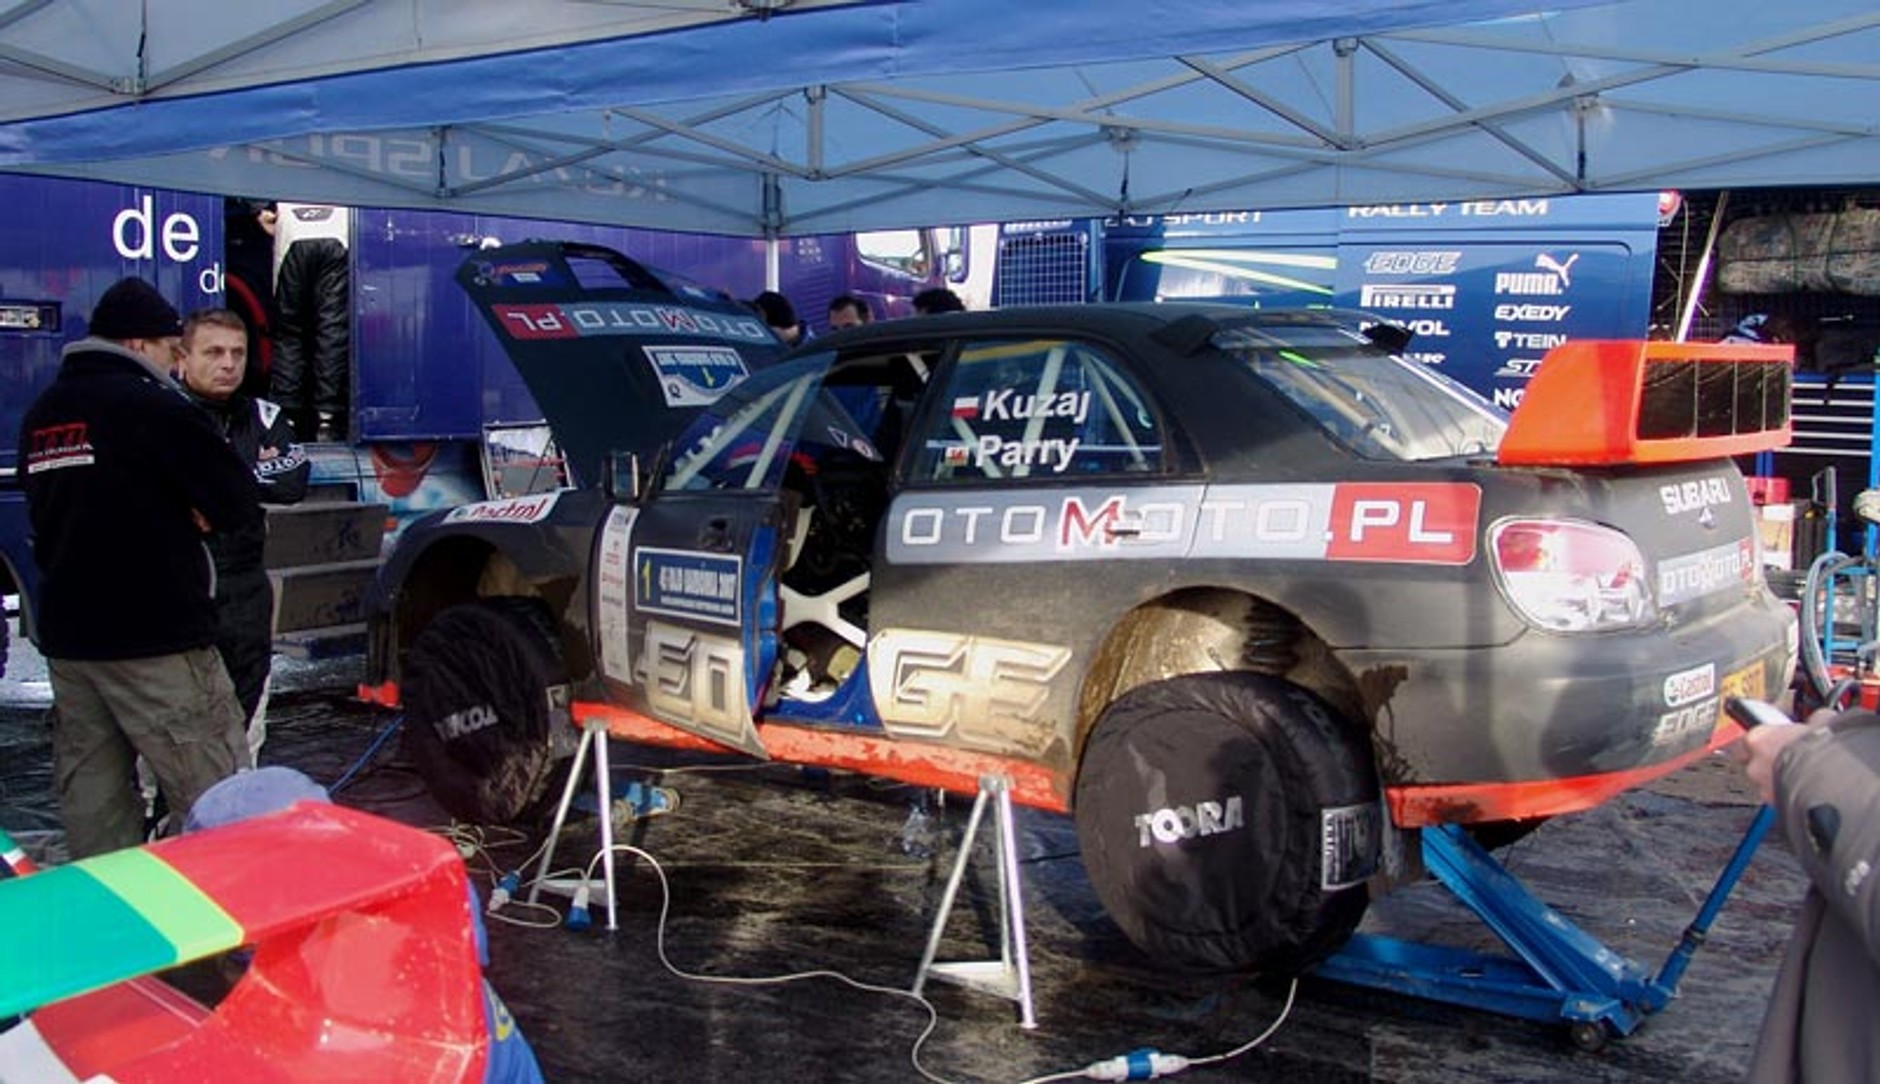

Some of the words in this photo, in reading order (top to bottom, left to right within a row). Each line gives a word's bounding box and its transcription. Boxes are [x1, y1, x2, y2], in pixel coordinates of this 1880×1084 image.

[1461, 200, 1548, 216] TEAM
[113, 196, 199, 262] de
[200, 262, 225, 293] d
[1364, 252, 1462, 274] EDGE
[1361, 285, 1456, 309] PIRELLI
[508, 307, 766, 338] OTOMOTO.PL
[1495, 305, 1571, 321] EXEDY
[1513, 332, 1567, 349] TEIN
[982, 389, 1091, 424] Kuzaj
[974, 434, 1081, 474] Parry
[1660, 478, 1731, 515] SUBARU
[902, 496, 1454, 555] OTOMOTO.PL
[1134, 795, 1245, 848] TOORA
